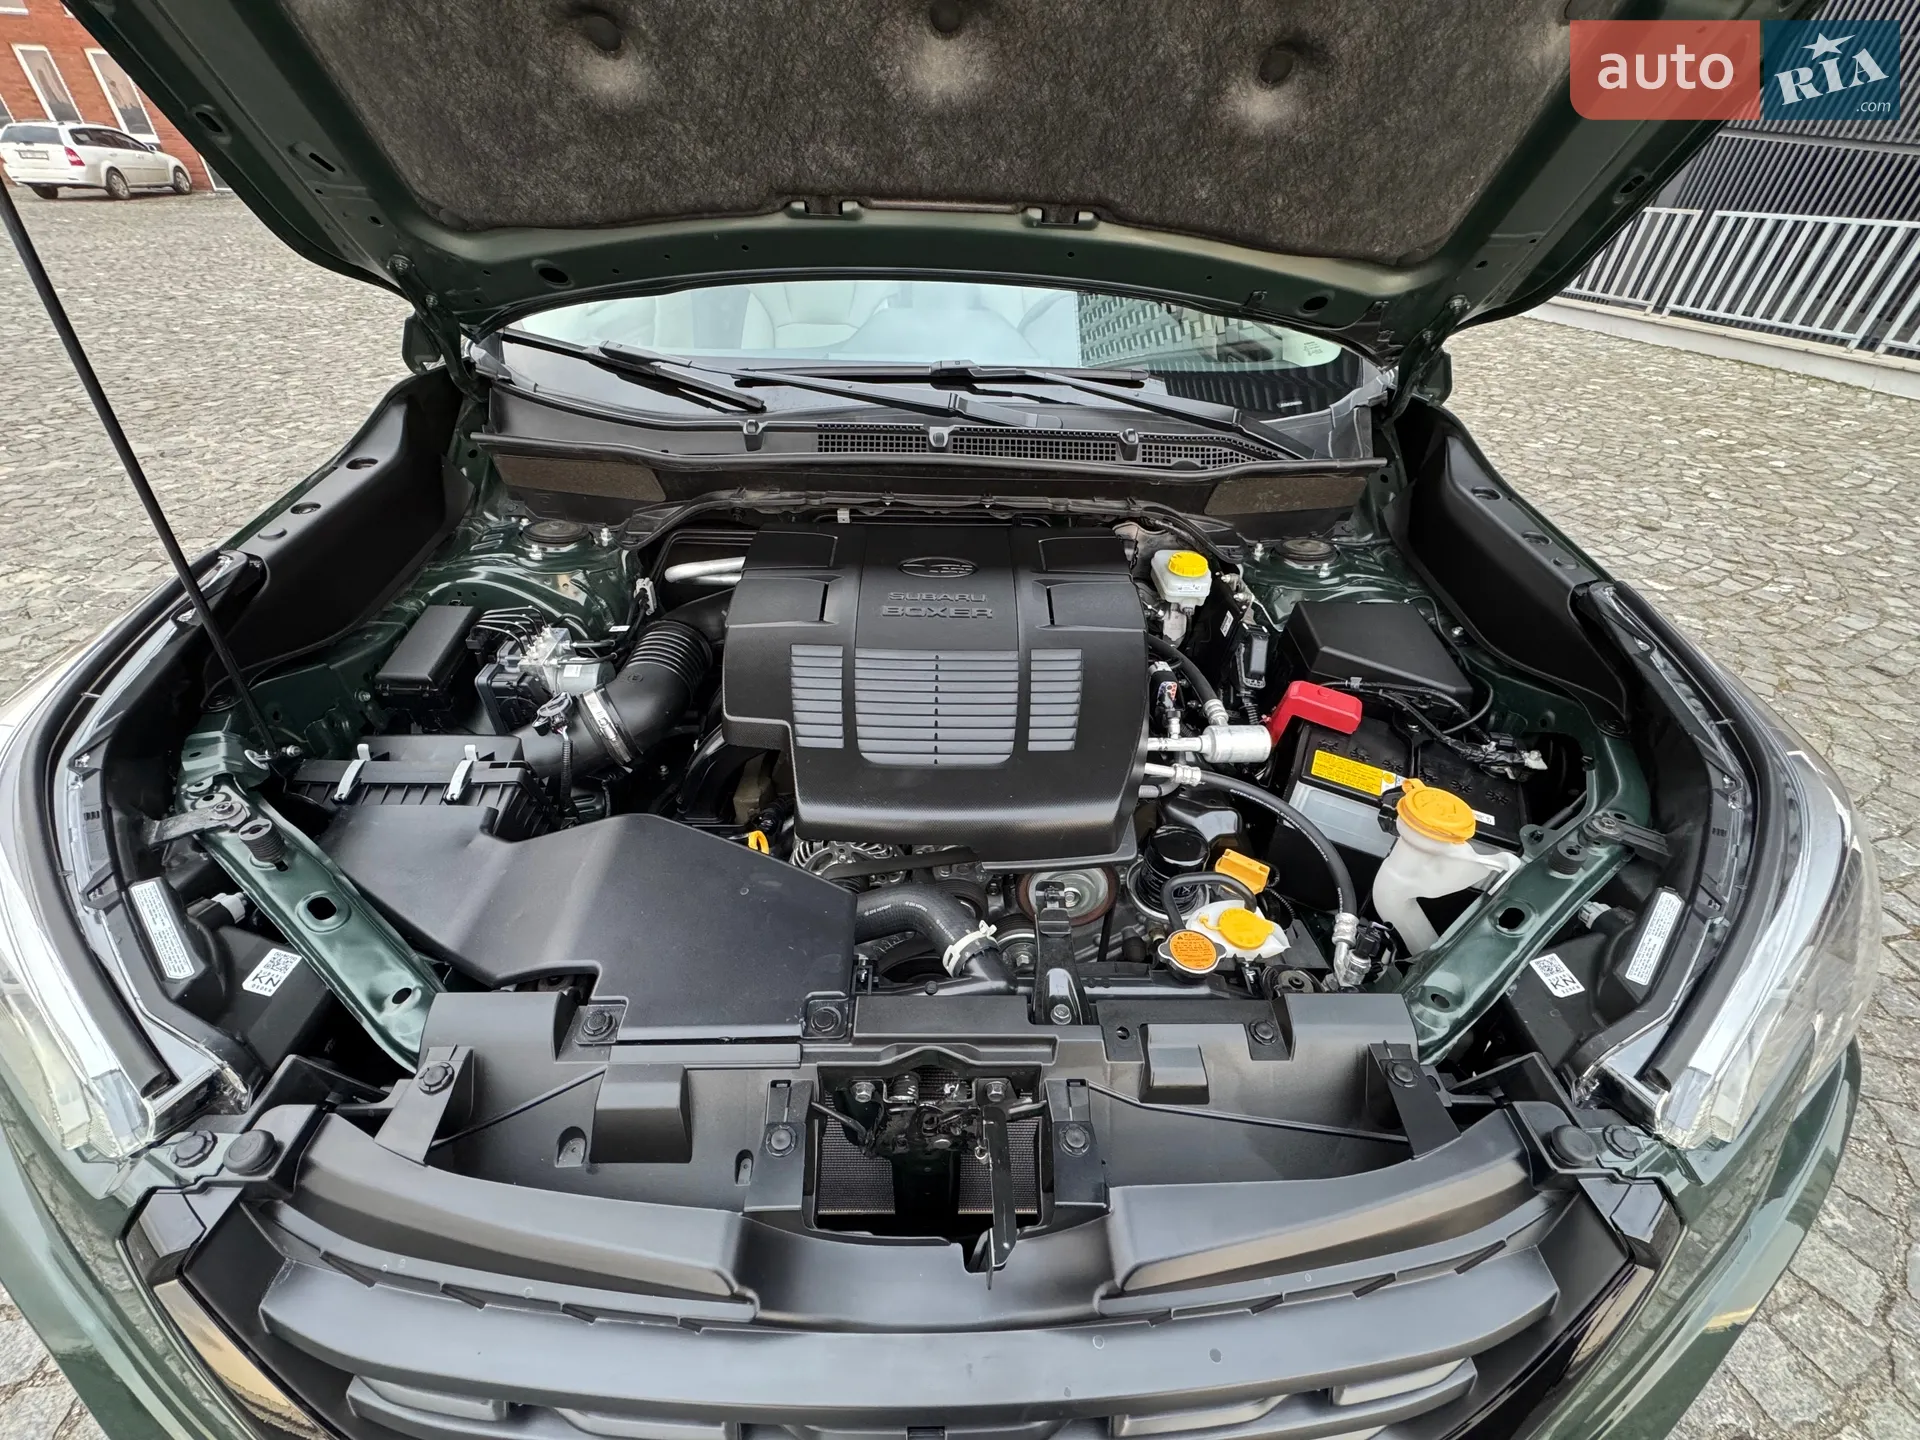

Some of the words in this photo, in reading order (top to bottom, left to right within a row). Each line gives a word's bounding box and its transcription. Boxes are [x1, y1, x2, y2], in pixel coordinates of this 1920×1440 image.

[888, 591, 986, 602] SUBARU
[882, 605, 993, 619] BOXER
[251, 973, 282, 988] KN
[1549, 976, 1577, 990] KN
